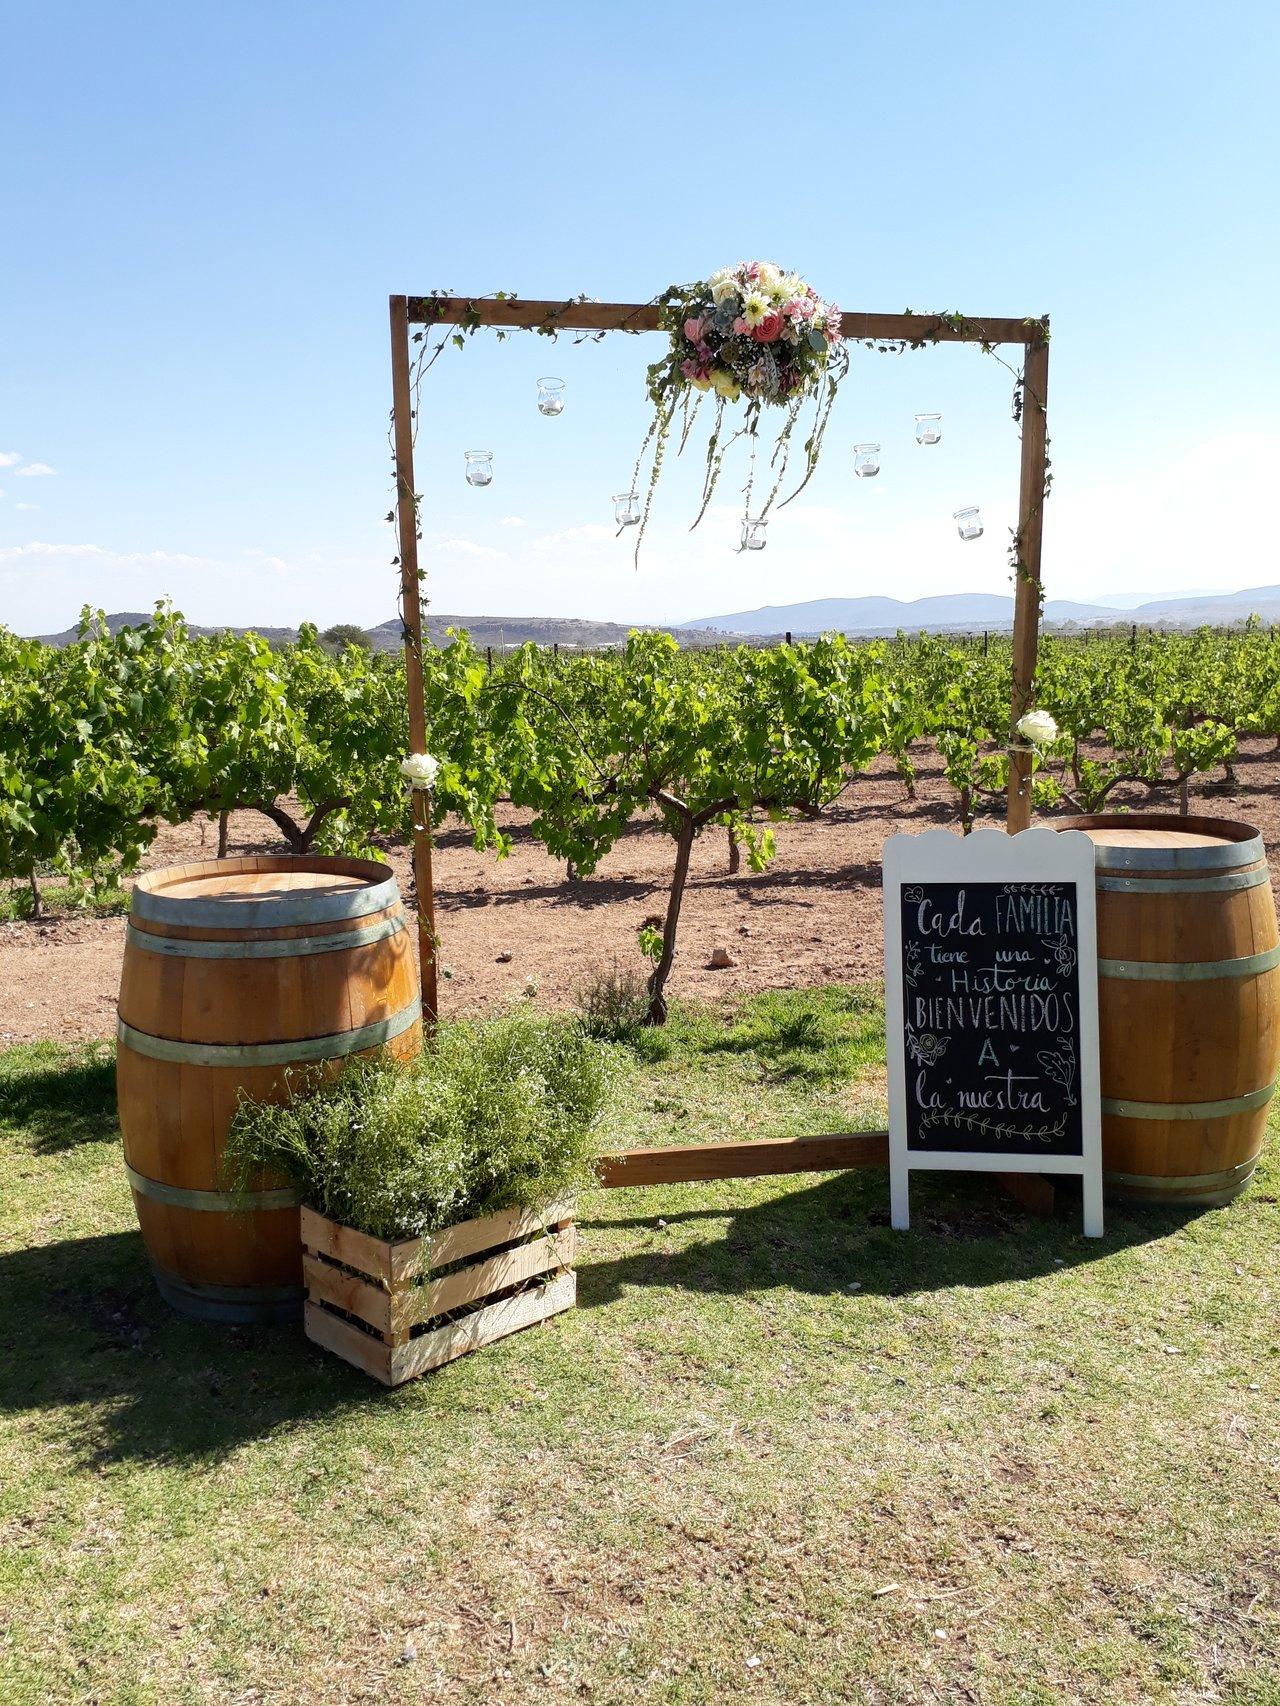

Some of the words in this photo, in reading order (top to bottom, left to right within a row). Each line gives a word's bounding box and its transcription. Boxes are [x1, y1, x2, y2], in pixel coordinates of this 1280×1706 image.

[917, 890, 986, 937] Cada
[996, 895, 1074, 936] FAMILIA
[924, 943, 970, 964] tiene
[995, 950, 1035, 962] una
[951, 963, 1058, 994] Historia
[915, 992, 1074, 1032] BIENVENIDOS
[977, 1036, 1000, 1066] A
[916, 1069, 946, 1109] la
[957, 1068, 1051, 1113] nuestra
